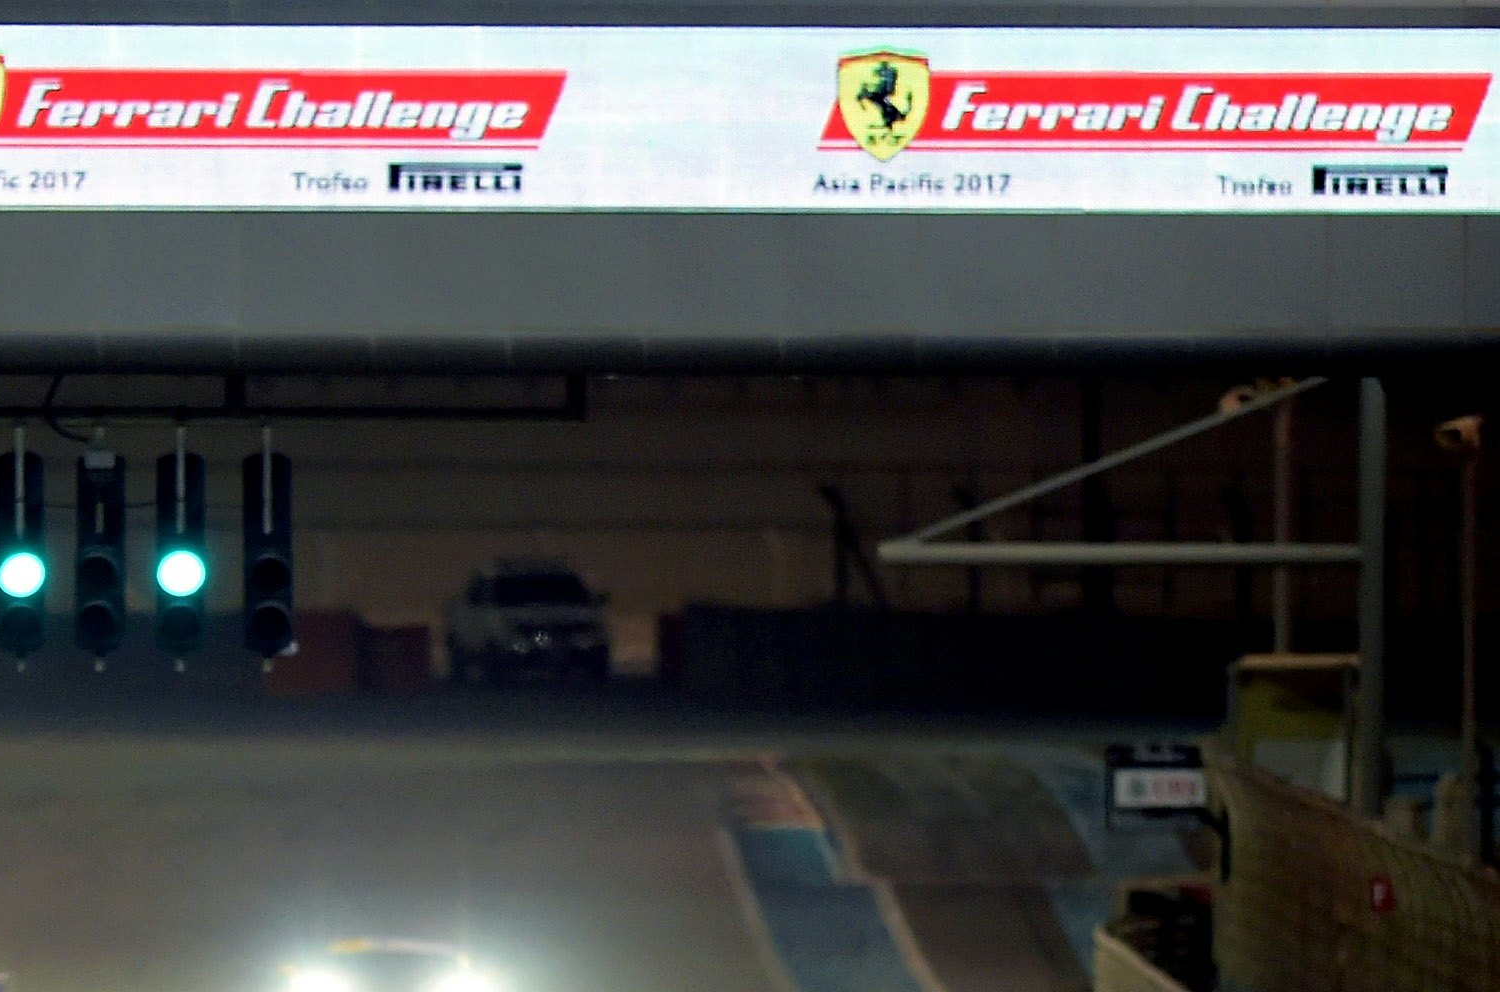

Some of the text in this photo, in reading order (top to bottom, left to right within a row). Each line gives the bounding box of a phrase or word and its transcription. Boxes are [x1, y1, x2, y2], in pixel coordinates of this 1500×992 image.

[16, 78, 529, 140] Ferrari Challenge
[941, 83, 1454, 143] Ferrari Challenge
[28, 171, 88, 192] 2017
[291, 162, 524, 193] Trofeo PIRELLI
[813, 173, 1012, 195] Asia Pacific 2017
[1218, 165, 1449, 196] Trofeo PIRELLI
